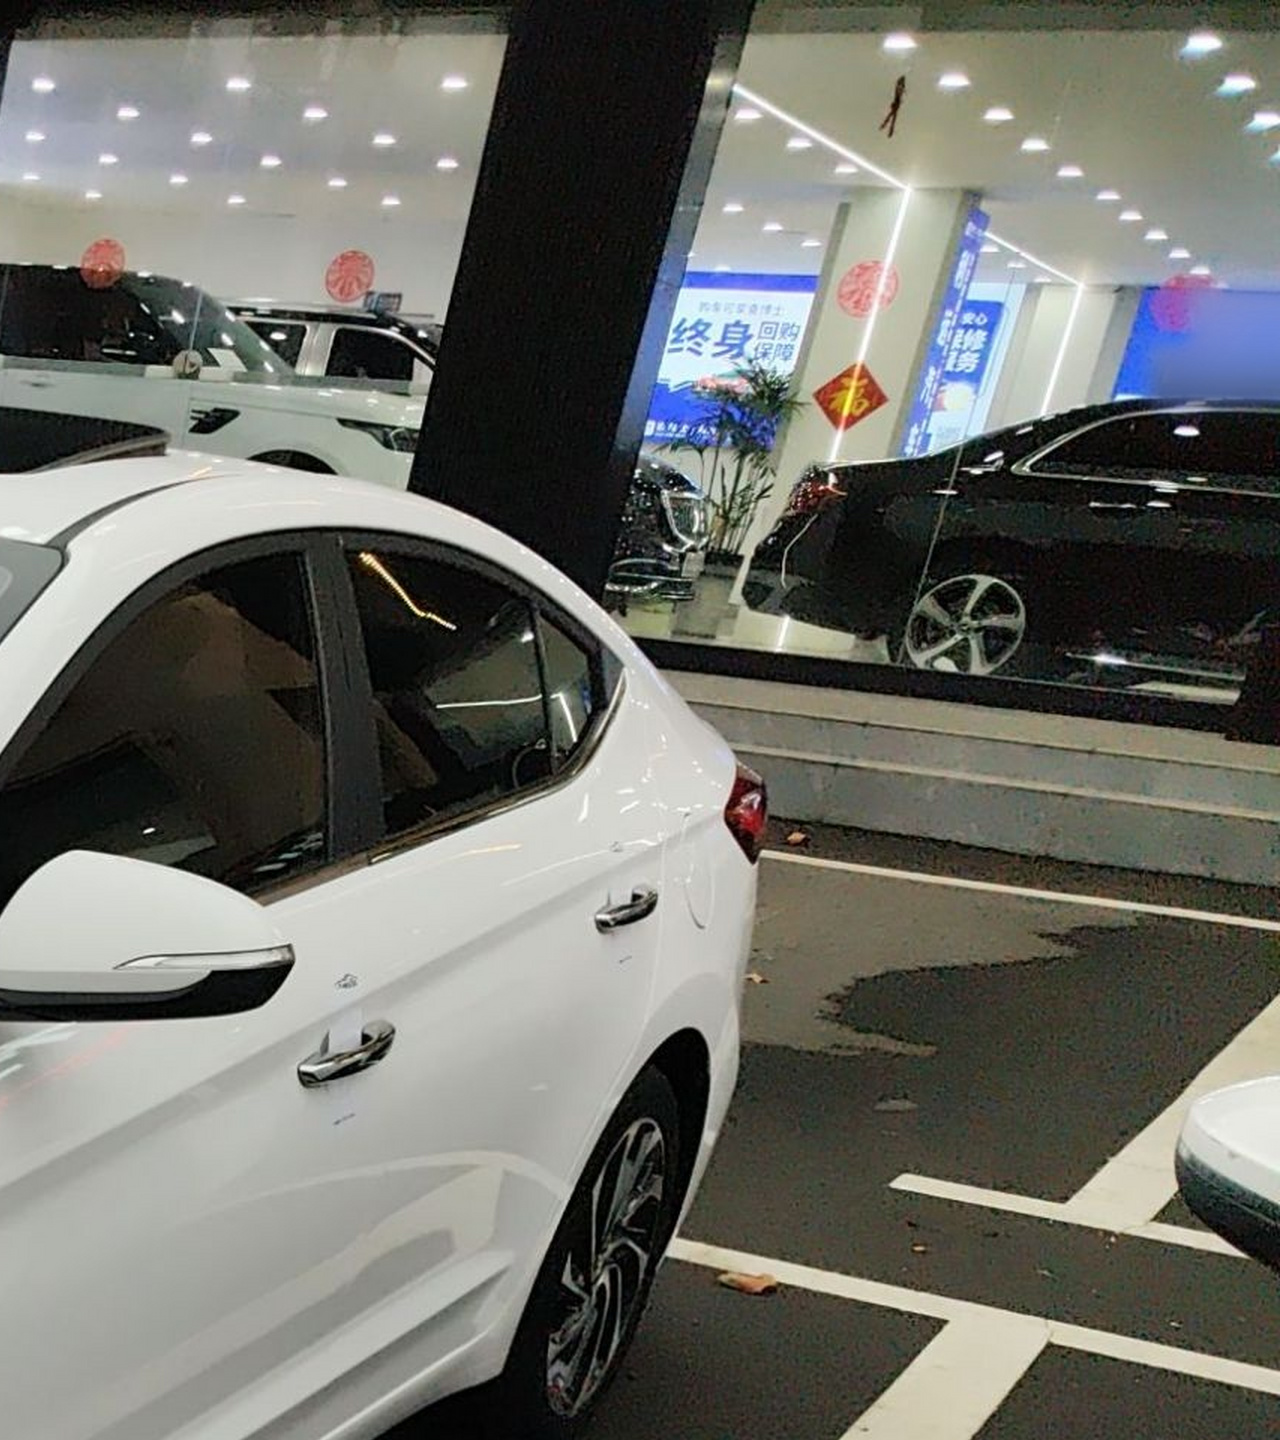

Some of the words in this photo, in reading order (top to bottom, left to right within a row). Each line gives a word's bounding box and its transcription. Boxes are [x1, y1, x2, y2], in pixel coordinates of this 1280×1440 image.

[667, 317, 753, 360] 终身
[757, 320, 800, 341] 回购
[753, 342, 795, 361] 保障
[829, 376, 870, 416] 福
